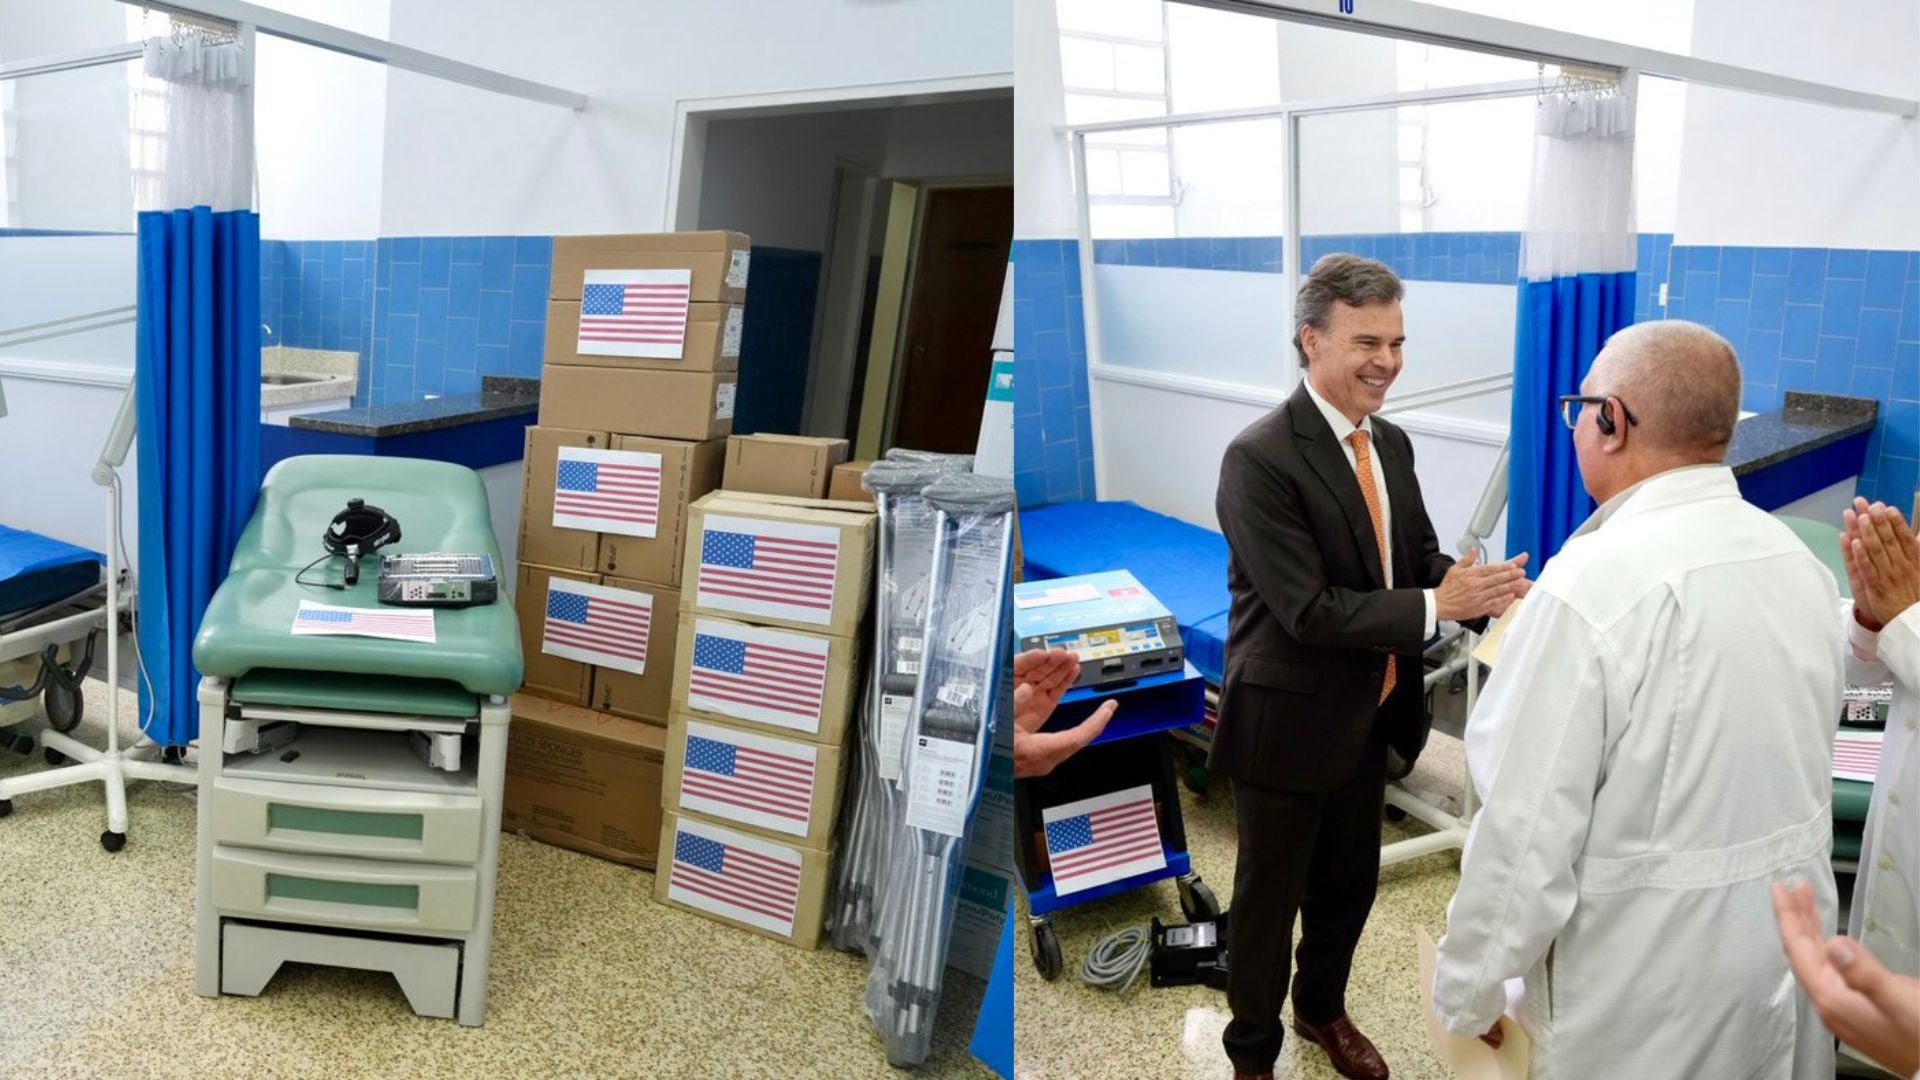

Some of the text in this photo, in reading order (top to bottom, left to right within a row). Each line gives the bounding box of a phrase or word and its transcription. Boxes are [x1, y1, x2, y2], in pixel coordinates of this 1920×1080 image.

[509, 732, 583, 759] AUZE SPONGES
[963, 881, 998, 901] mond
